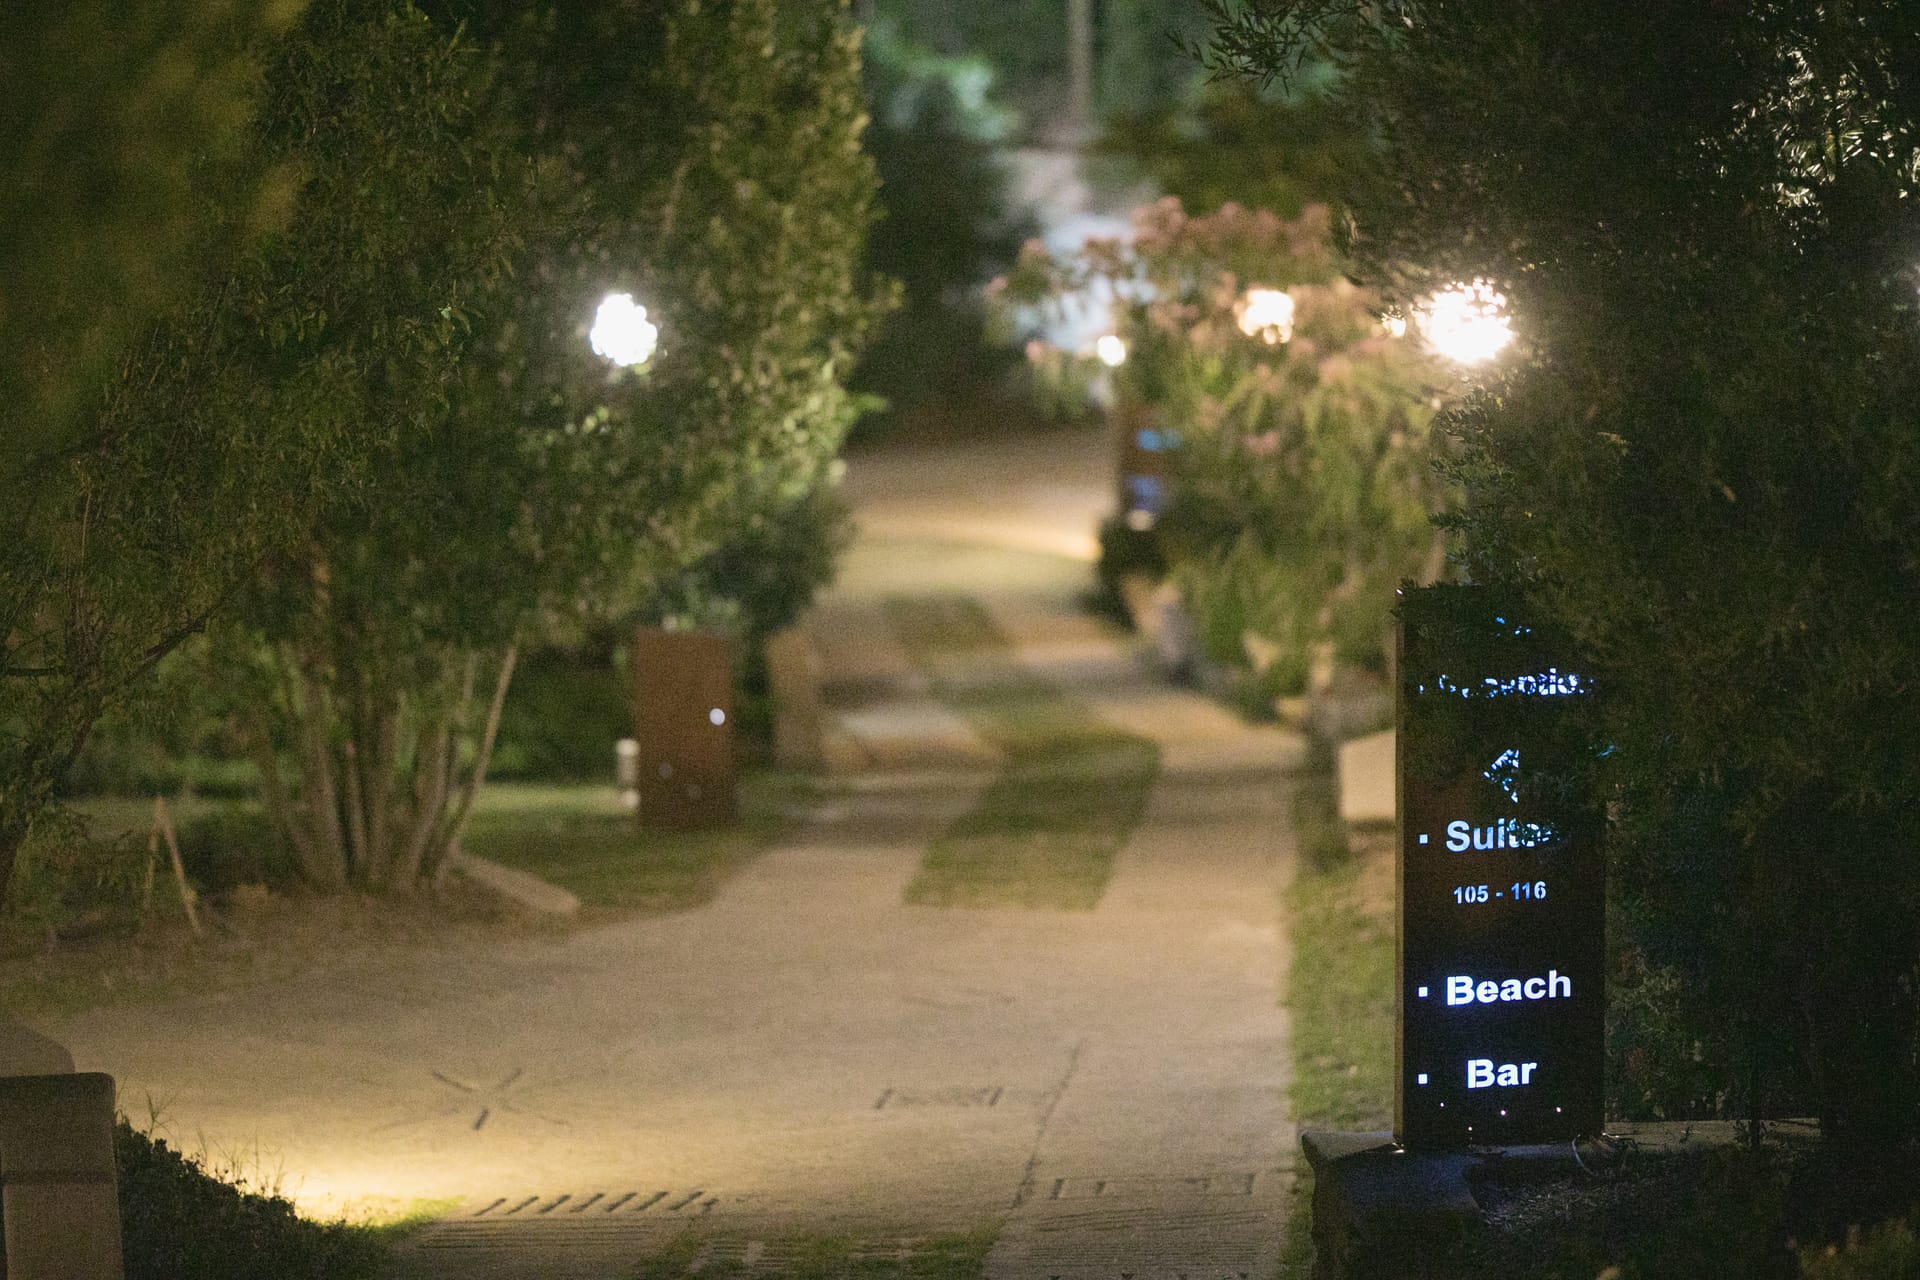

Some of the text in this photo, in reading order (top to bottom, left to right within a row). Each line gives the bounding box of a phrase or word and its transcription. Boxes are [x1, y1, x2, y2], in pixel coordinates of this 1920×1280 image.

[1453, 885, 1489, 905] 105
[1511, 881, 1547, 901] 116
[1446, 969, 1572, 1007] Beach
[1466, 1058, 1538, 1090] Bar
